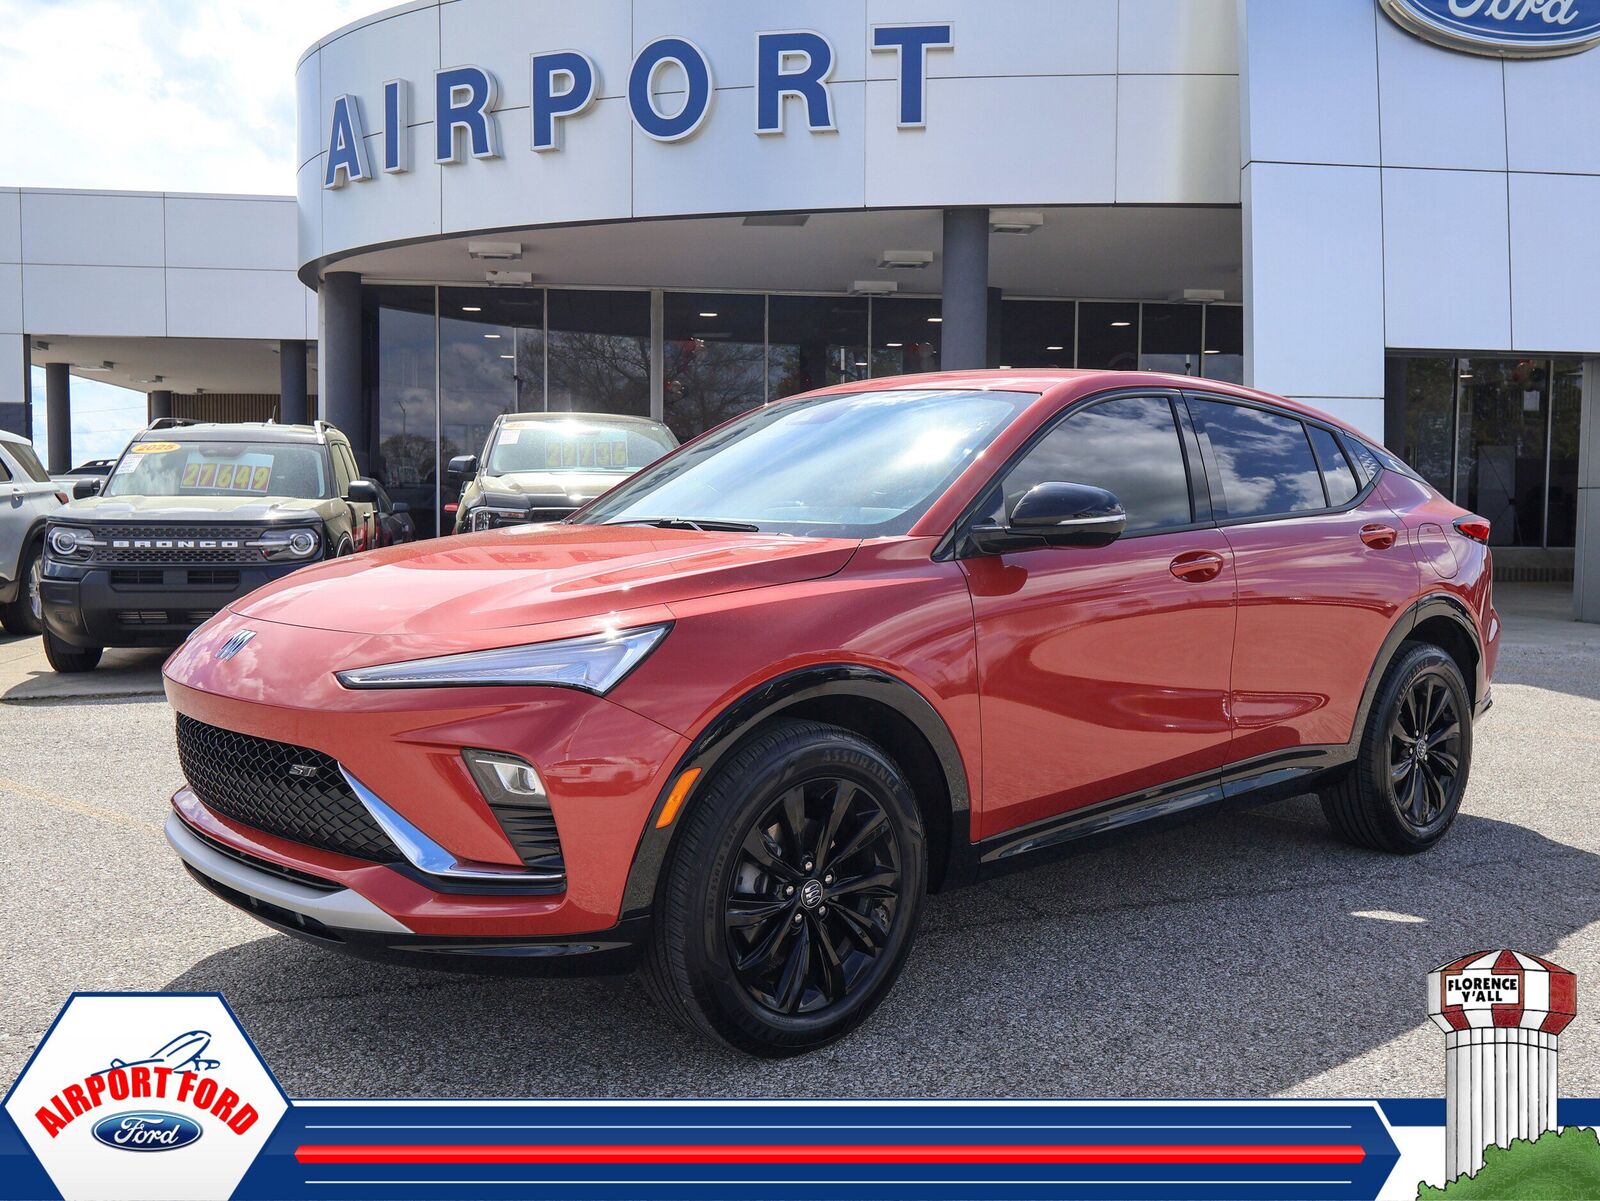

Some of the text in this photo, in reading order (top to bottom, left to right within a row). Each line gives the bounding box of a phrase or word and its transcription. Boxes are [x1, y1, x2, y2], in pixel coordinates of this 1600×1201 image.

[323, 21, 955, 191] AIRPORT
[182, 463, 270, 489] 27649
[112, 540, 239, 548] BRONCO
[289, 764, 318, 777] ST
[822, 750, 903, 793] ASSURANCE
